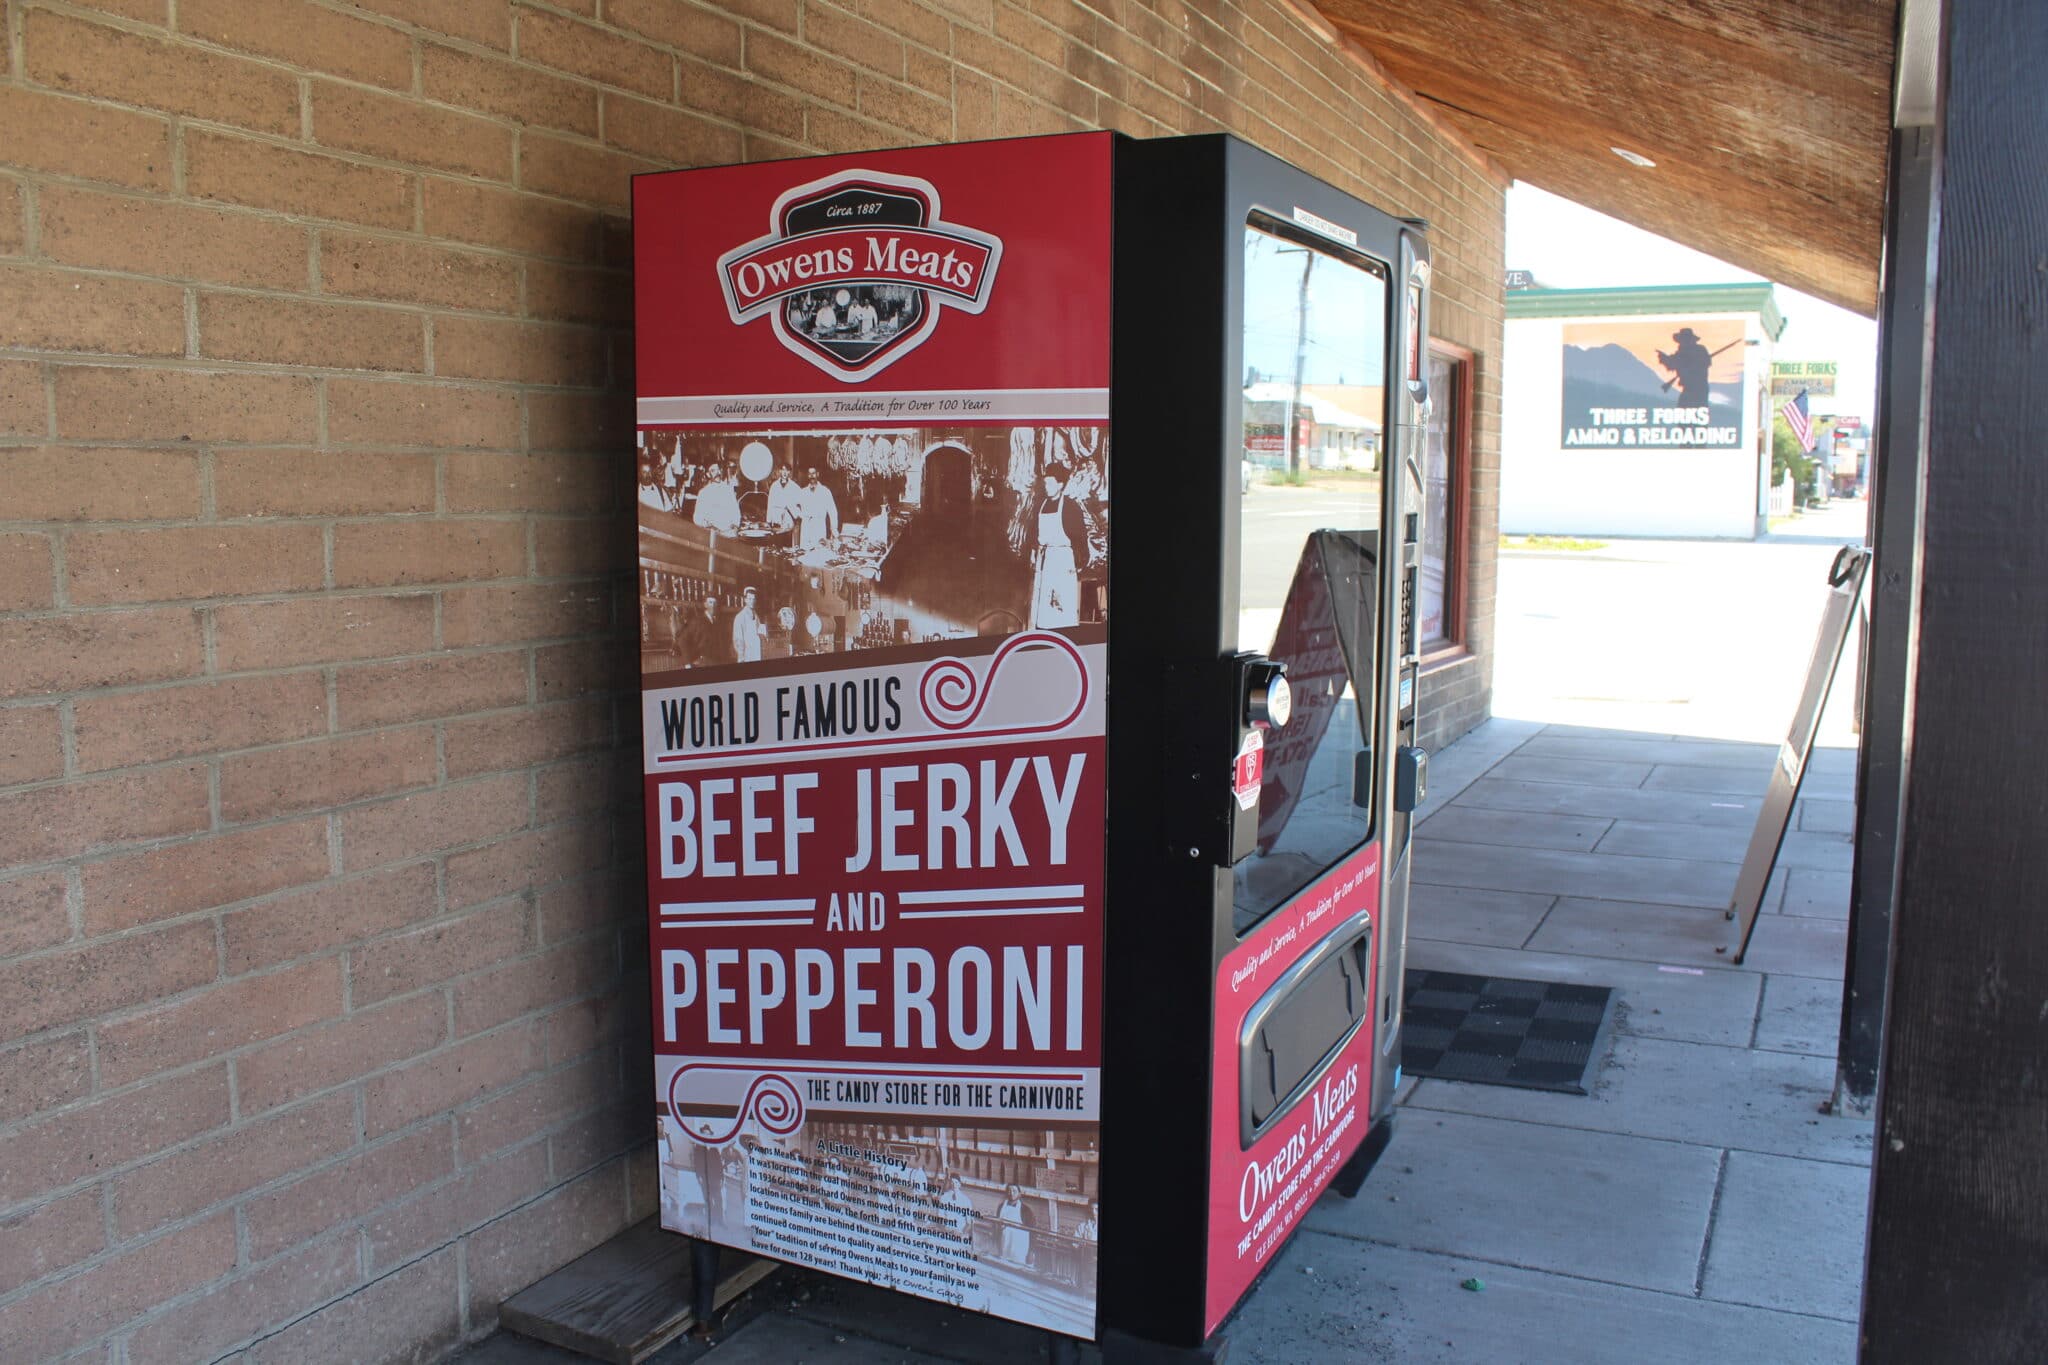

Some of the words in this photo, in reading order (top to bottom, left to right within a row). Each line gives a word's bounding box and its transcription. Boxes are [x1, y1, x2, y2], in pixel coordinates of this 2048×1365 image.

[826, 206, 853, 218] Circa
[856, 203, 883, 215] 1887
[737, 247, 854, 298] Owens
[863, 236, 974, 288] Meats
[1771, 362, 1802, 375] THREE
[1806, 362, 1837, 375] FORKS
[713, 402, 751, 418] Quality
[753, 401, 773, 413] and
[776, 401, 815, 414] Service,
[820, 402, 829, 412] A
[834, 398, 884, 412] Tradition
[887, 398, 905, 417] for
[908, 400, 934, 411] Over
[939, 399, 958, 410] 100
[961, 399, 992, 410] Years
[1565, 428, 1619, 445] AMMO
[1623, 428, 1636, 445] &
[1638, 427, 1737, 445] RELOADING
[1590, 407, 1647, 426] THREE
[1653, 406, 1709, 425] FORKS
[661, 691, 759, 751] WORLD
[776, 676, 901, 741] FAMOUS
[658, 771, 819, 880] BEEF
[845, 752, 1088, 874] JERKY
[826, 892, 885, 932] AND
[1231, 955, 1258, 992] Quality
[1259, 937, 1273, 965] and
[1306, 896, 1332, 927] Tradition
[1332, 886, 1342, 915] for
[1342, 880, 1354, 898] Over
[661, 944, 1084, 1051] PEPPERONI
[807, 1079, 830, 1101] THE
[836, 1080, 879, 1104] CANDY
[885, 1082, 928, 1106] STORE
[935, 1083, 960, 1107] FOR
[966, 1084, 993, 1108] THE
[999, 1085, 1084, 1110] CARNIVORE
[749, 1142, 773, 1155] Owens
[774, 1148, 797, 1161] Meats
[814, 1158, 841, 1171] started
[842, 1162, 851, 1176] by
[853, 1167, 883, 1181] Morgan
[884, 1173, 911, 1187] Owens
[912, 1181, 920, 1190] in
[817, 1140, 825, 1150] A
[829, 1141, 860, 1157] Little
[864, 1150, 907, 1171] History
[1240, 1123, 1307, 1223] Owens
[1310, 1063, 1358, 1145] Meats
[749, 1156, 755, 1164] It
[757, 1158, 771, 1167] was
[772, 1161, 799, 1176] located
[801, 1168, 808, 1177] in
[810, 1170, 822, 1181] the
[824, 1173, 839, 1185] coal
[841, 1179, 868, 1194] mining
[869, 1185, 889, 1197] town
[891, 1189, 900, 1199] of
[901, 1192, 930, 1208] Roslyn,
[750, 1170, 757, 1179] In
[759, 1172, 777, 1185] 1936
[777, 1176, 809, 1193] Grandpa
[810, 1184, 838, 1199] Richard
[840, 1192, 866, 1206] Owens
[867, 1199, 893, 1213] moved
[894, 1205, 901, 1214] it
[902, 1207, 911, 1217] to
[913, 1211, 927, 1221] our
[928, 1214, 958, 1228] current
[1237, 1231, 1252, 1259] THE
[1252, 1199, 1278, 1241] CANDY
[1278, 1174, 1299, 1211] STORE
[1299, 1158, 1312, 1185] FOR
[1313, 1143, 1324, 1168] THE
[1324, 1105, 1355, 1153] CARNIVORE
[750, 1184, 779, 1198] location
[781, 1192, 788, 1200] in
[790, 1193, 801, 1204] Cle
[802, 1197, 824, 1210] Elum.
[824, 1202, 844, 1216] Now,
[845, 1205, 858, 1217] the
[859, 1210, 880, 1224] forth
[881, 1217, 896, 1228] and
[897, 1219, 915, 1232] fifth
[917, 1227, 962, 1244] generation
[963, 1236, 973, 1246] of
[750, 1198, 763, 1209] the
[764, 1201, 789, 1215] Owens
[789, 1206, 813, 1223] family
[814, 1215, 827, 1224] are
[828, 1216, 855, 1232] behind
[856, 1223, 869, 1235] the
[871, 1229, 901, 1243] counter
[902, 1236, 911, 1246] to
[912, 1239, 934, 1251] serve
[935, 1245, 951, 1257] you
[952, 1249, 971, 1260] with
[750, 1213, 788, 1228] continued
[788, 1222, 837, 1240] commitment
[838, 1234, 846, 1243] to
[847, 1236, 875, 1252] quality
[876, 1244, 892, 1255] and
[892, 1249, 922, 1263] service.
[924, 1255, 945, 1268] Start
[946, 1261, 955, 1270] or
[956, 1262, 976, 1277] keep
[751, 1238, 769, 1251] have
[770, 1243, 781, 1254] for
[782, 1248, 798, 1259] over
[800, 1251, 813, 1262] 128
[814, 1256, 837, 1269] years!
[839, 1261, 863, 1275] Thank
[776, 1232, 808, 1247] tradition
[810, 1240, 818, 1250] of
[819, 1243, 847, 1259] serving
[848, 1250, 873, 1264] Owens
[875, 1257, 899, 1271] Meats
[900, 1264, 909, 1273] to
[910, 1267, 929, 1280] your
[929, 1271, 956, 1288] family
[957, 1279, 966, 1288] as
[967, 1281, 980, 1290] we
